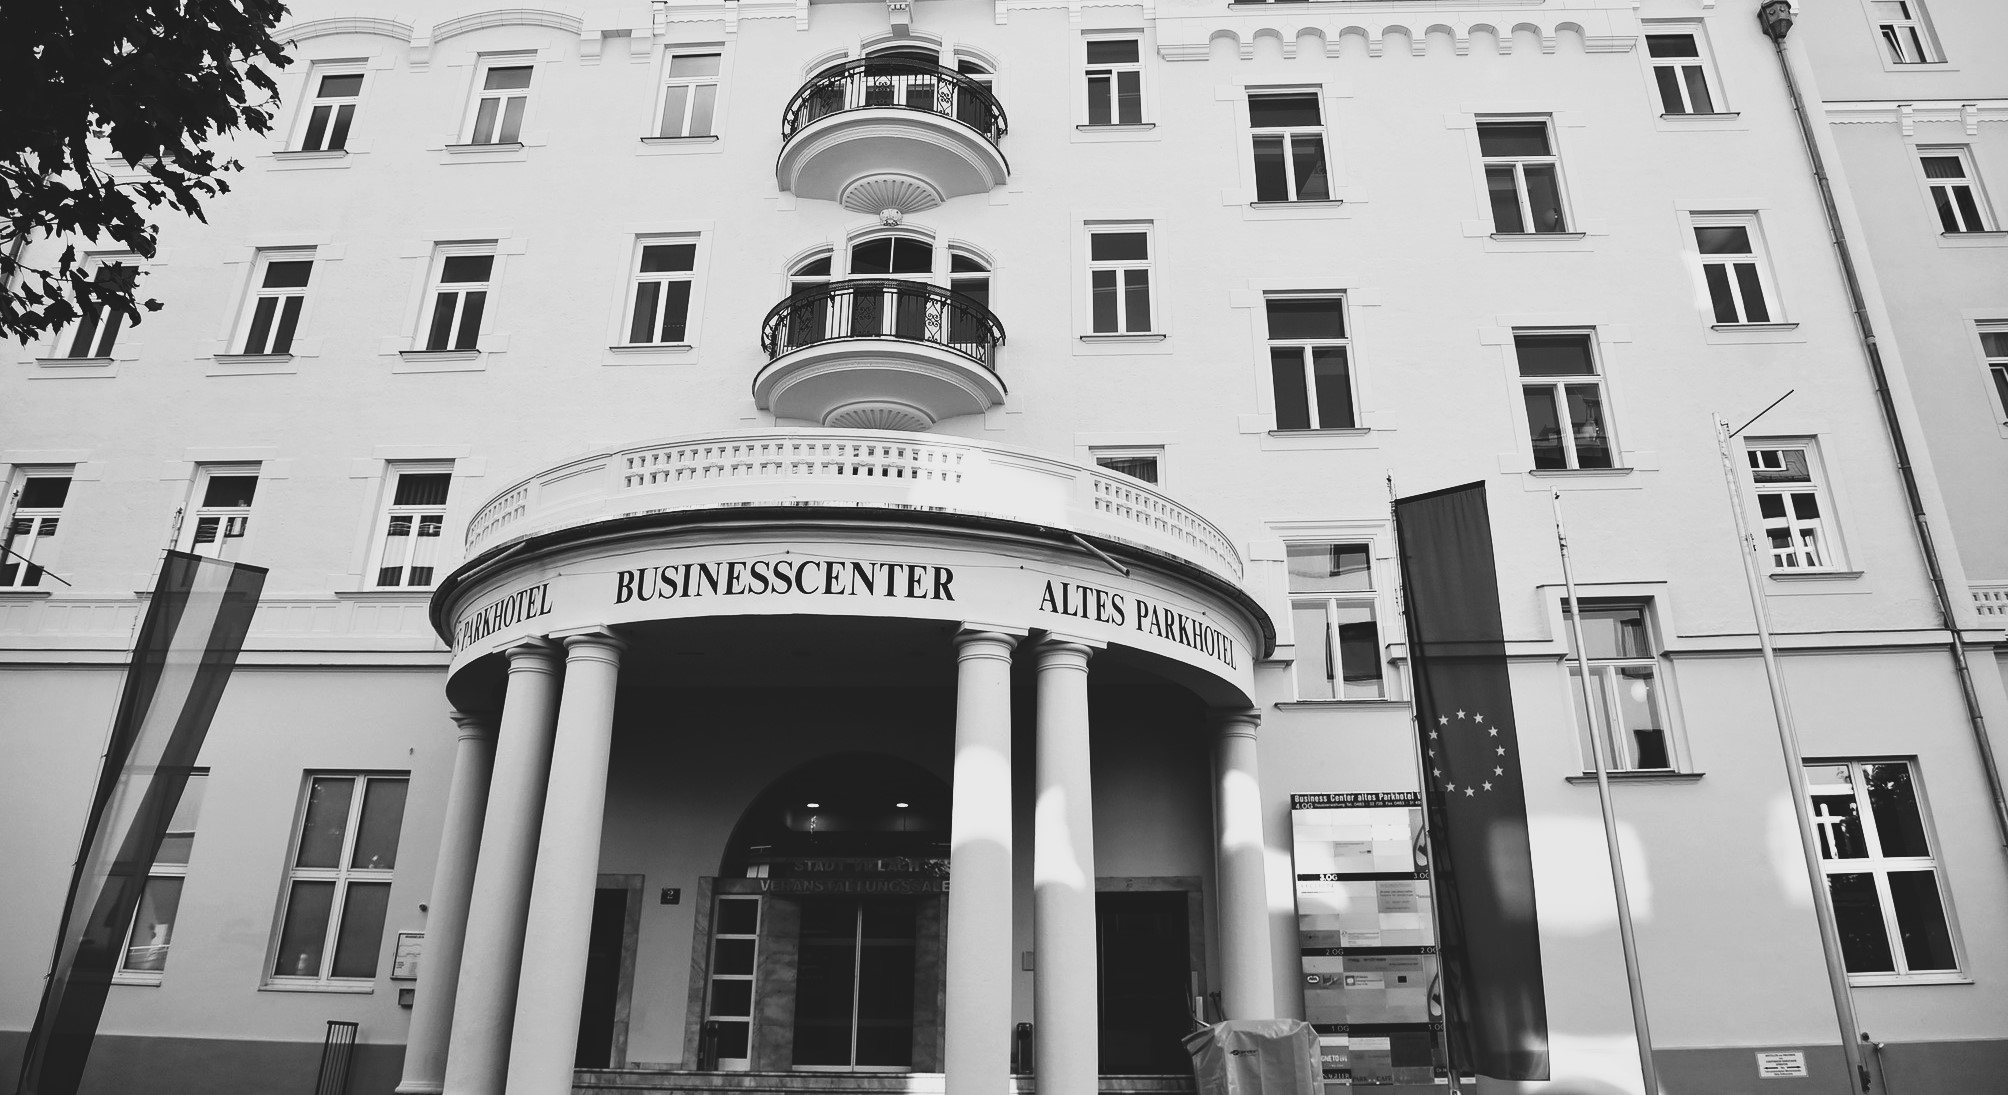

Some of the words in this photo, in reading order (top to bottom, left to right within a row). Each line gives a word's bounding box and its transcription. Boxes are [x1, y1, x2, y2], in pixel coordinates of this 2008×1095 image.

[614, 560, 955, 604] BUSINESSCENTER
[461, 583, 553, 652] PARKHOTEL
[1038, 579, 1126, 627] ALTES
[1134, 598, 1237, 671] PARKHOTEL
[1294, 794, 1328, 803] Business
[1330, 793, 1354, 802] Center
[1357, 793, 1377, 802] altes
[1379, 792, 1414, 801] Parkhotel
[794, 859, 844, 872] STADT
